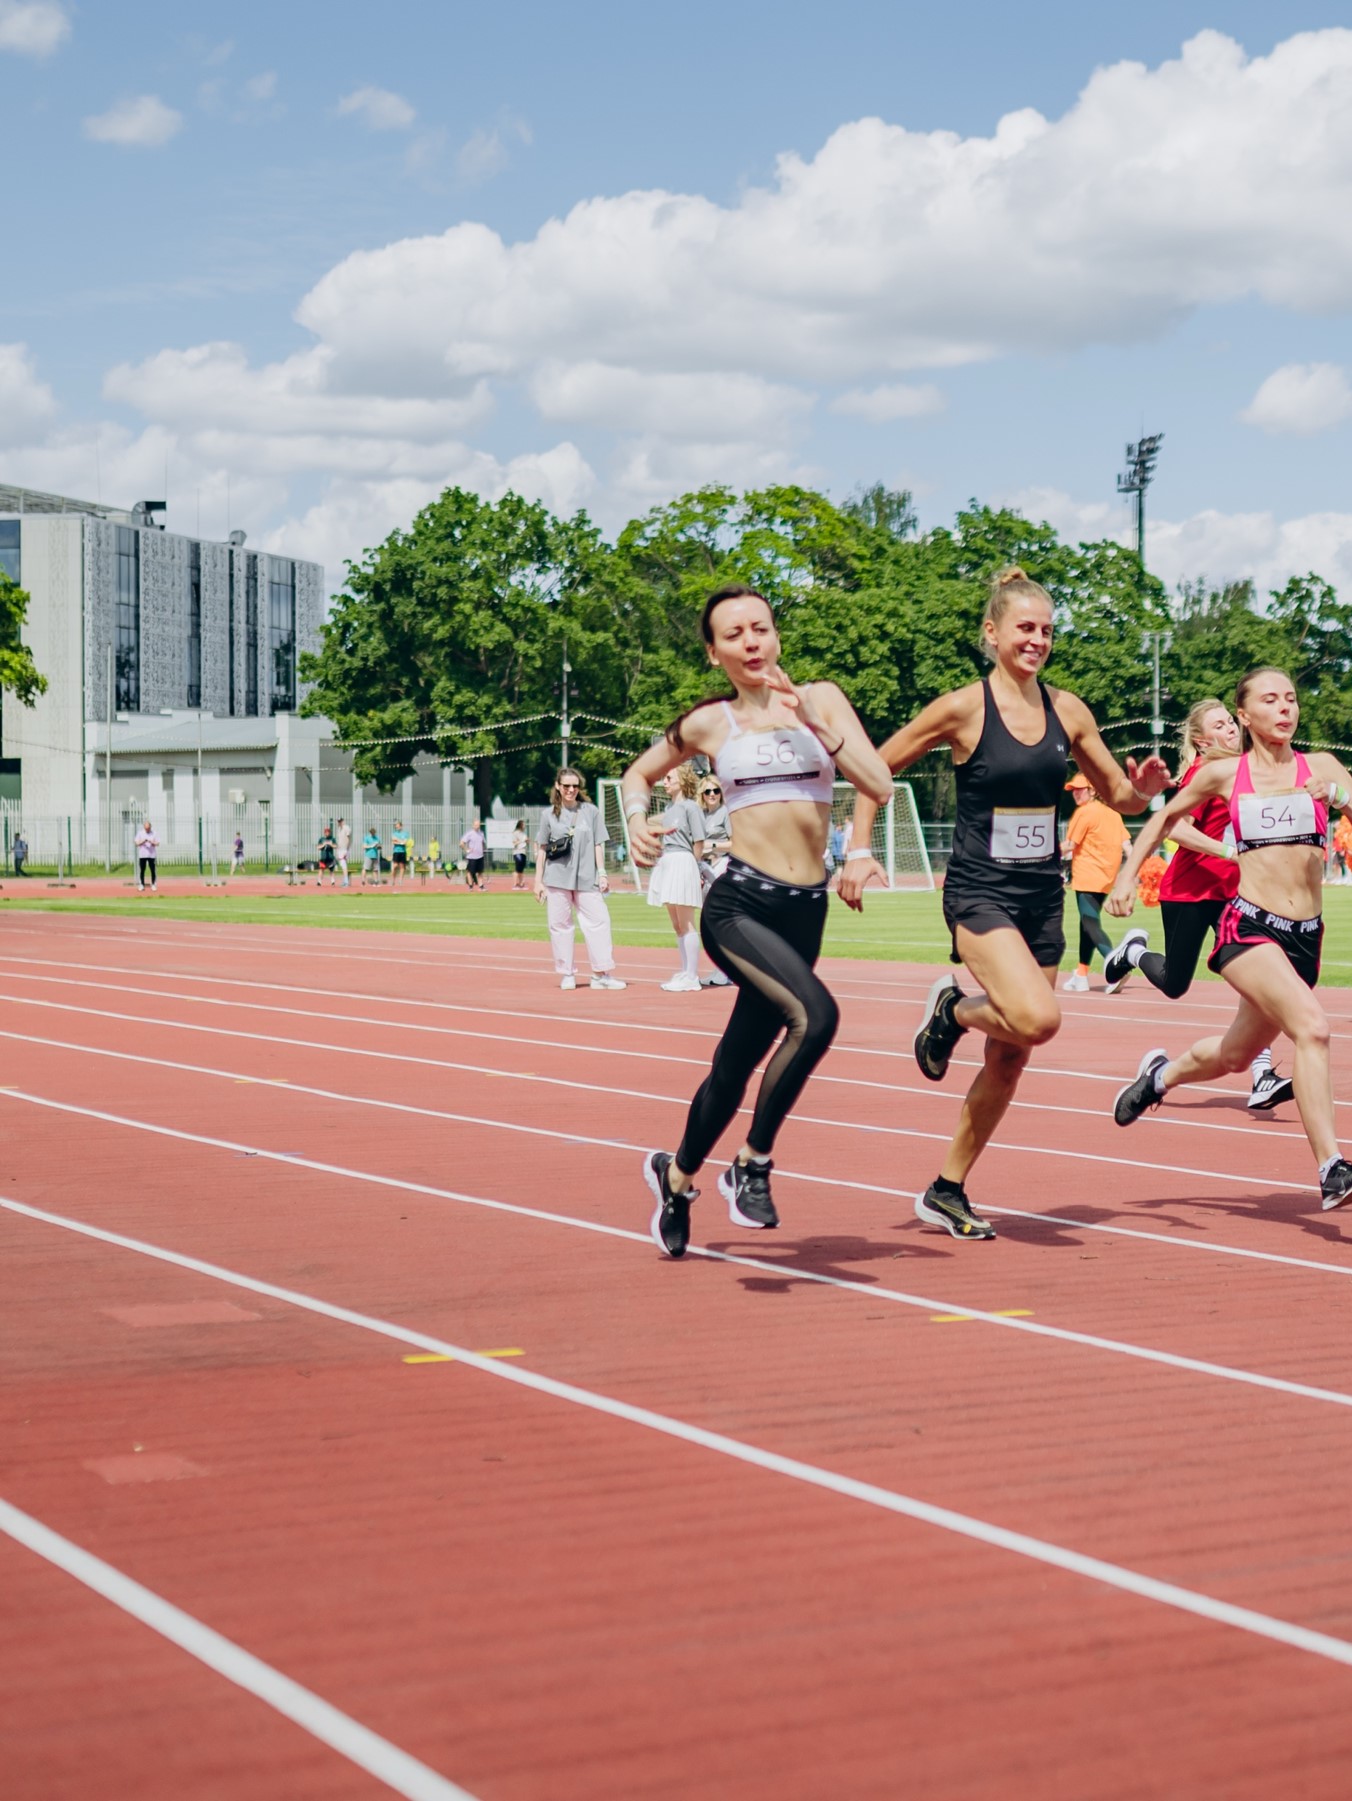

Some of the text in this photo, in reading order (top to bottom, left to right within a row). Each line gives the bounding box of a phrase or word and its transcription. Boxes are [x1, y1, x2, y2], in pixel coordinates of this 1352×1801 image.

[756, 739, 796, 766] 56
[1261, 805, 1296, 829] 54
[1015, 825, 1045, 848] 55
[1234, 898, 1319, 934] PINK PINK PINK
